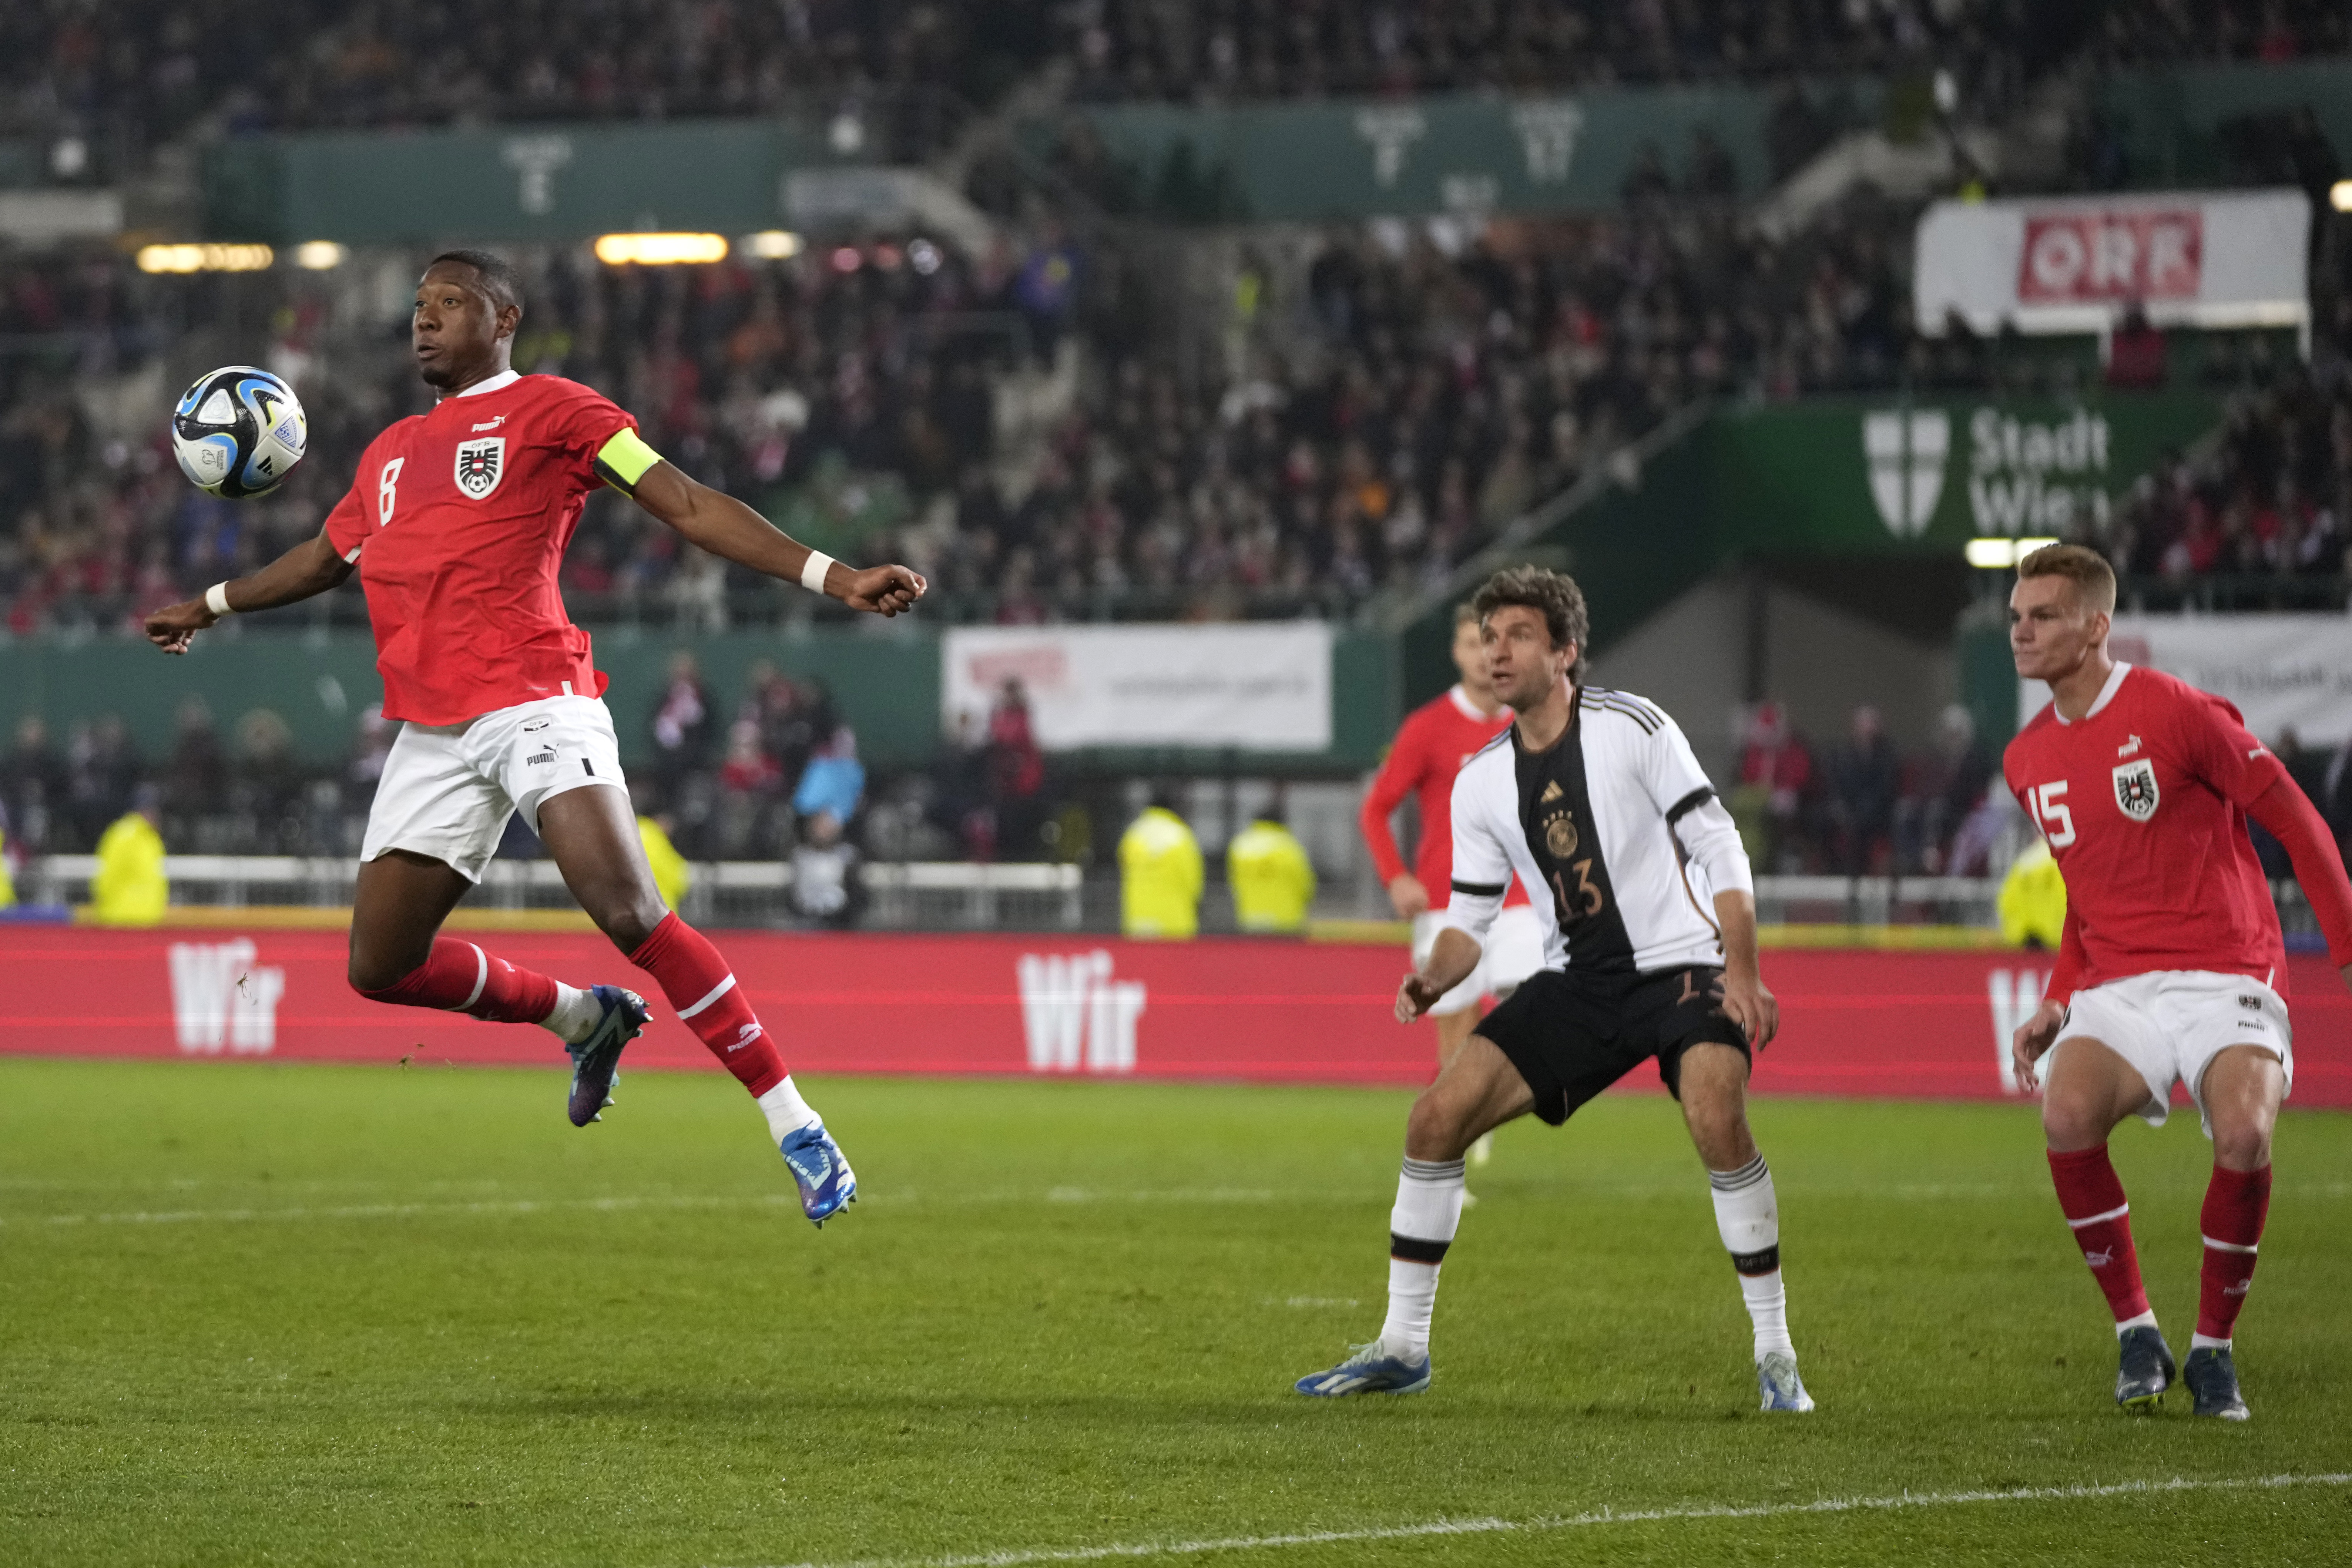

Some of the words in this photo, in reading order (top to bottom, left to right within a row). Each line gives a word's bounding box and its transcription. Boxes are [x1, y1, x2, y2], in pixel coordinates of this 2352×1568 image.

[1970, 407, 2109, 471] Stadt
[379, 457, 405, 527] 8
[527, 753, 555, 767] PUMA
[2028, 779, 2076, 850] 15
[1553, 858, 1603, 921] 13
[1018, 948, 1145, 1070] Wir
